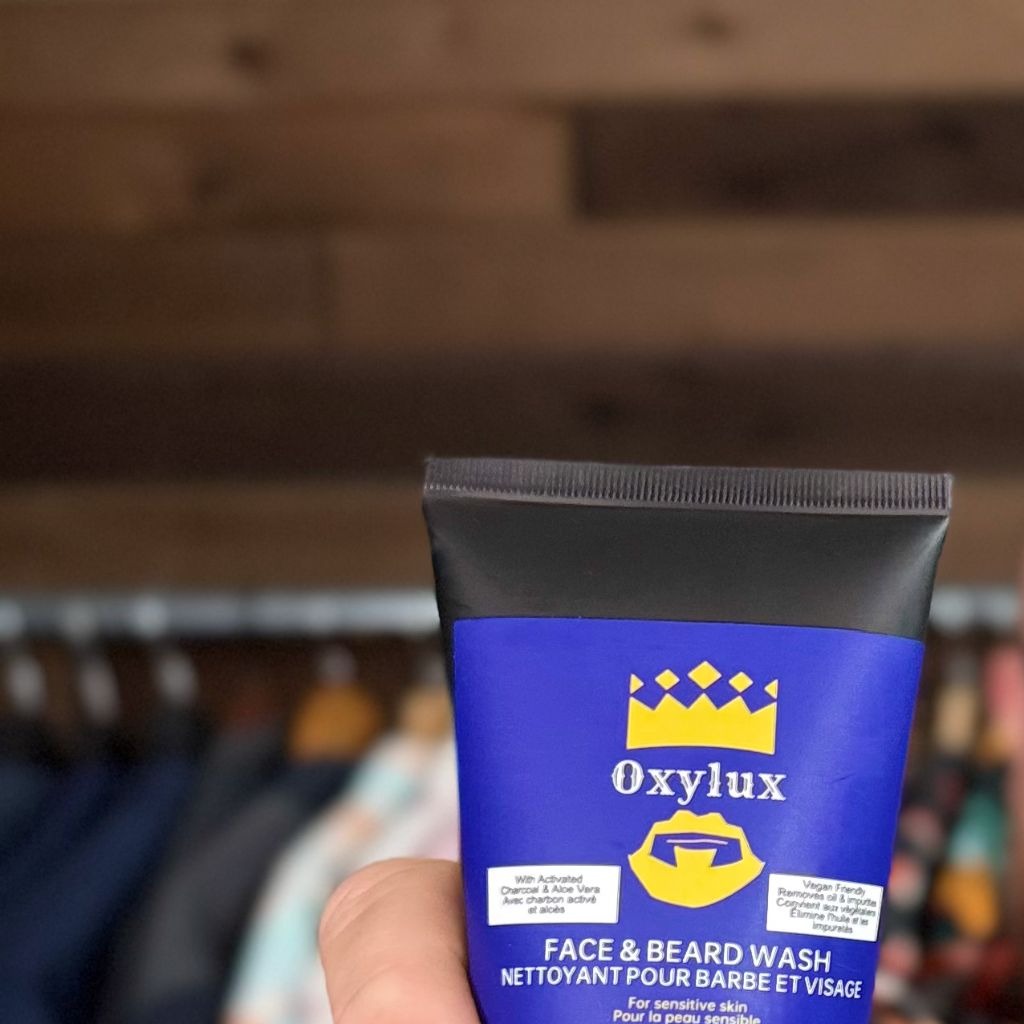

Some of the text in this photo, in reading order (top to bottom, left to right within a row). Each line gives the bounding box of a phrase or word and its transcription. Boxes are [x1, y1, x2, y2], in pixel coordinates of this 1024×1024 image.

[611, 759, 787, 806] Oxylux
[515, 875, 583, 884] With Activated
[501, 885, 600, 895] Charcoal & Aloe Vera
[778, 888, 825, 900] Removes
[826, 894, 838, 902] oil
[803, 880, 866, 896] Vegan Friendly
[503, 897, 523, 905] Avec
[526, 896, 564, 904] charbon
[776, 898, 821, 910] Convient
[544, 938, 832, 973] FACE & BEARD WASH
[501, 966, 863, 999] NETTOYANT POUR BARBE ET VISAGE
[628, 996, 748, 1014] For sensitive skin
[613, 1009, 645, 1023] Pour
[648, 1010, 662, 1023] la
